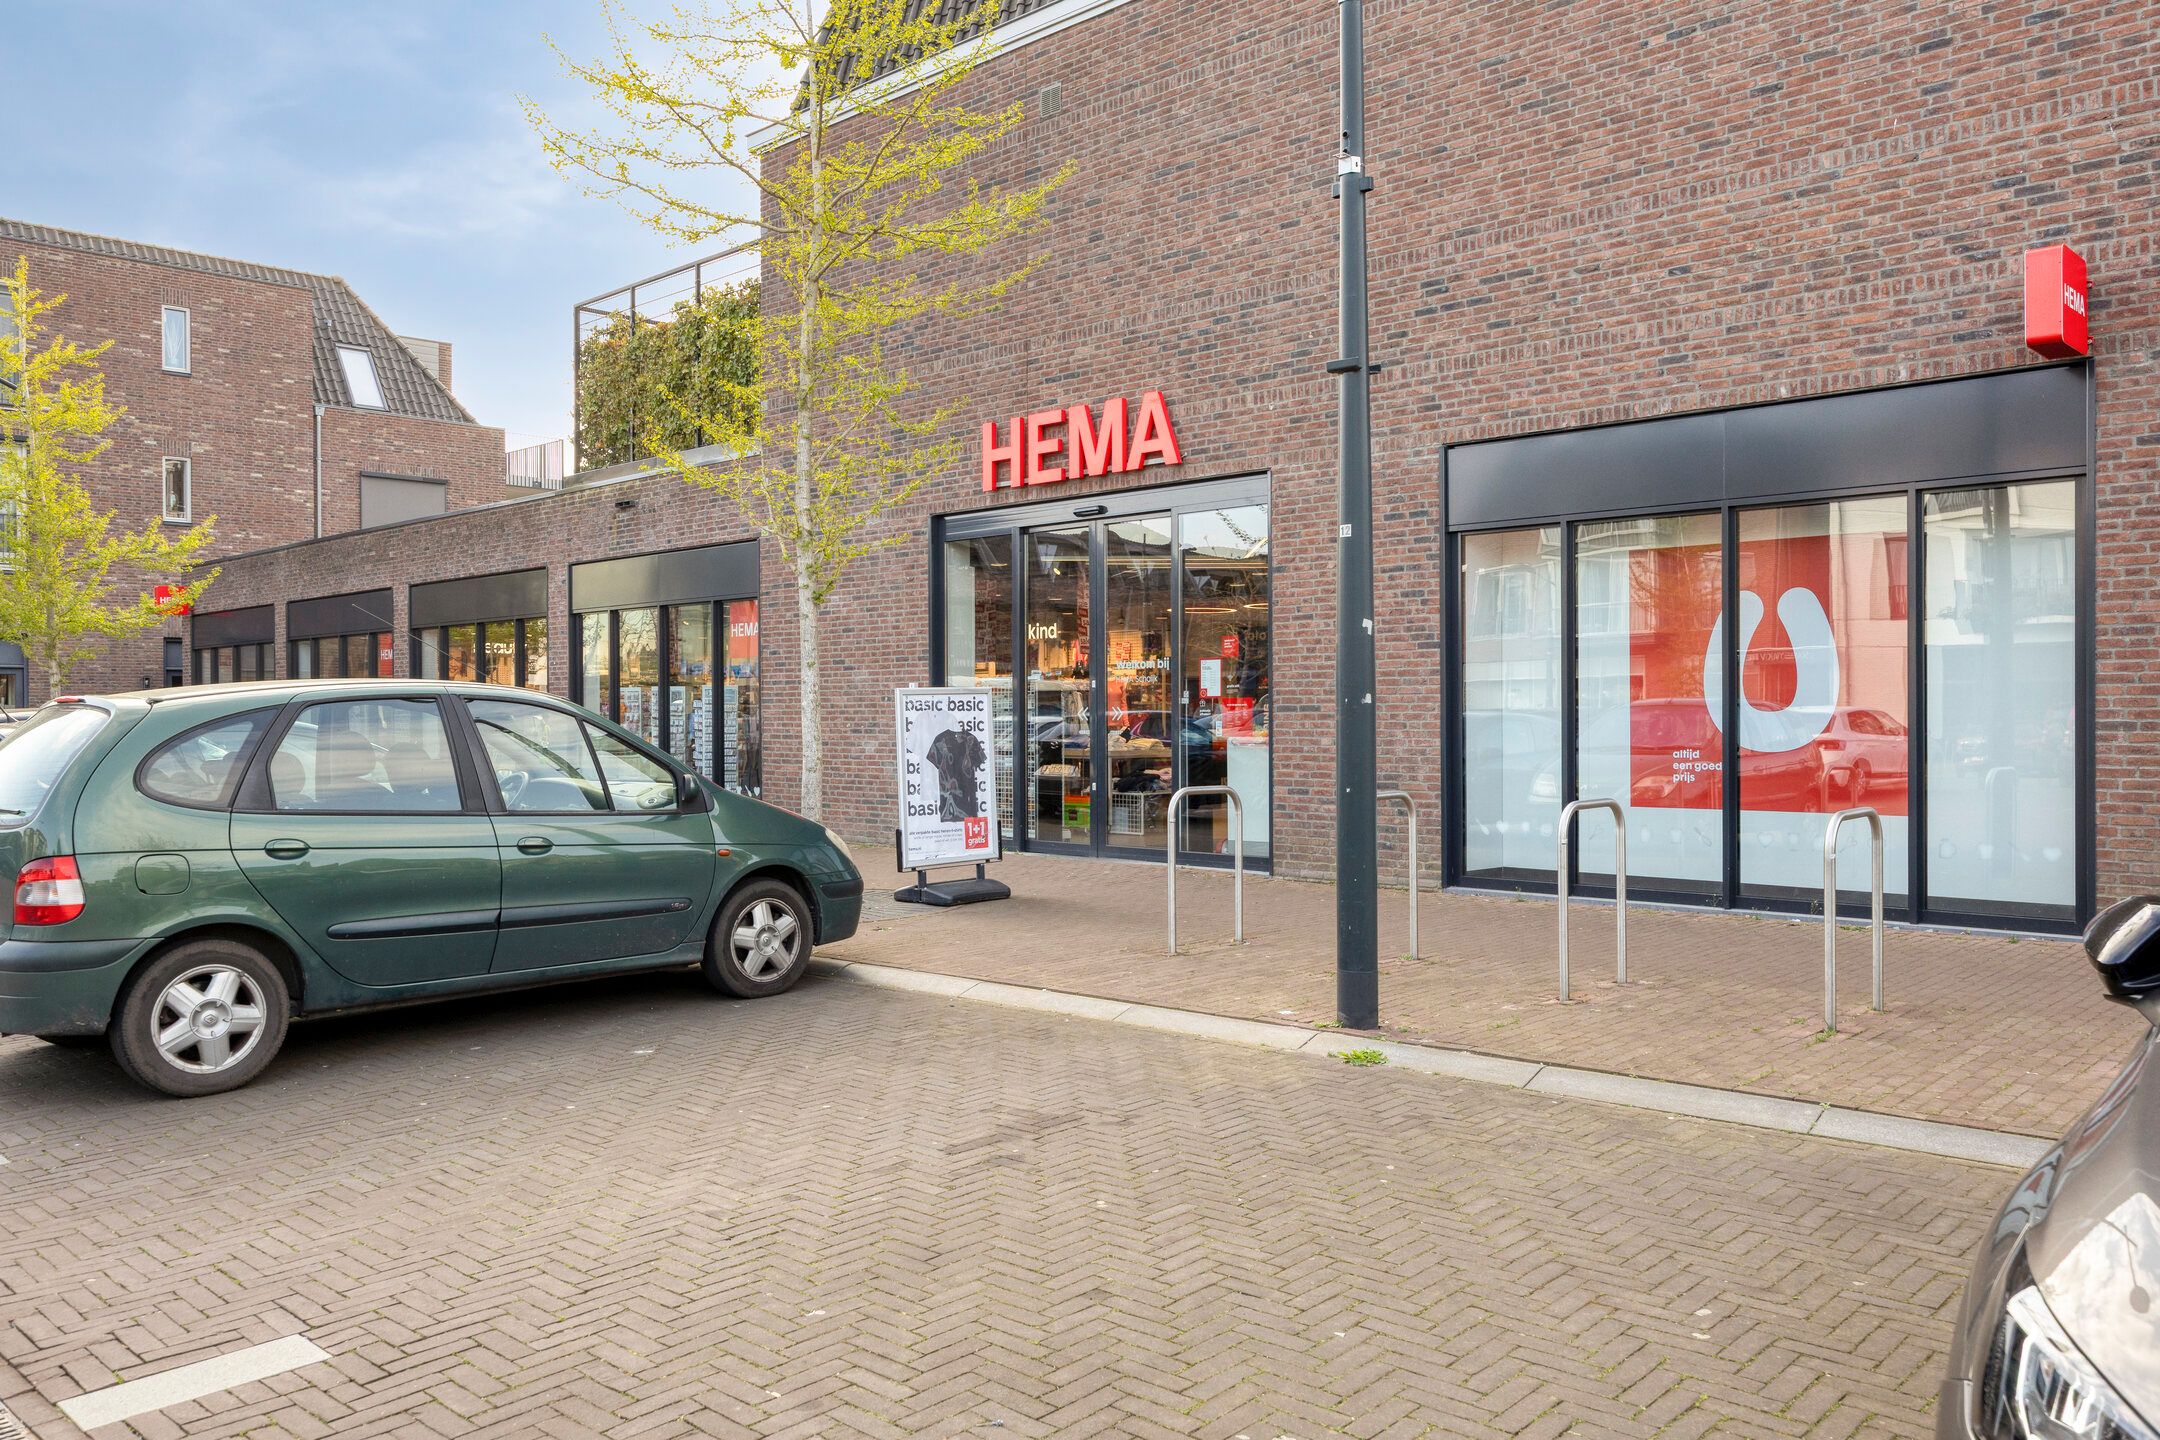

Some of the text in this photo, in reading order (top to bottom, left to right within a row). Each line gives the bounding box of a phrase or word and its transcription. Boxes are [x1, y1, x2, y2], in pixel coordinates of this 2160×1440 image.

[2064, 283, 2085, 317] HEMA
[982, 390, 1182, 492] HEMA
[1340, 525, 1351, 536] 12
[731, 622, 759, 637] HEMA
[1028, 623, 1058, 640] kind
[380, 649, 393, 661] HEM
[1157, 657, 1170, 671] bij
[905, 696, 984, 712] basic basic
[958, 716, 985, 732] asic
[1673, 749, 1700, 760] altijd
[1673, 762, 1723, 772] een goed
[1673, 772, 1696, 783] prijs
[908, 800, 941, 817] basi
[967, 821, 986, 837] 1+1
[968, 837, 986, 847] gratis
